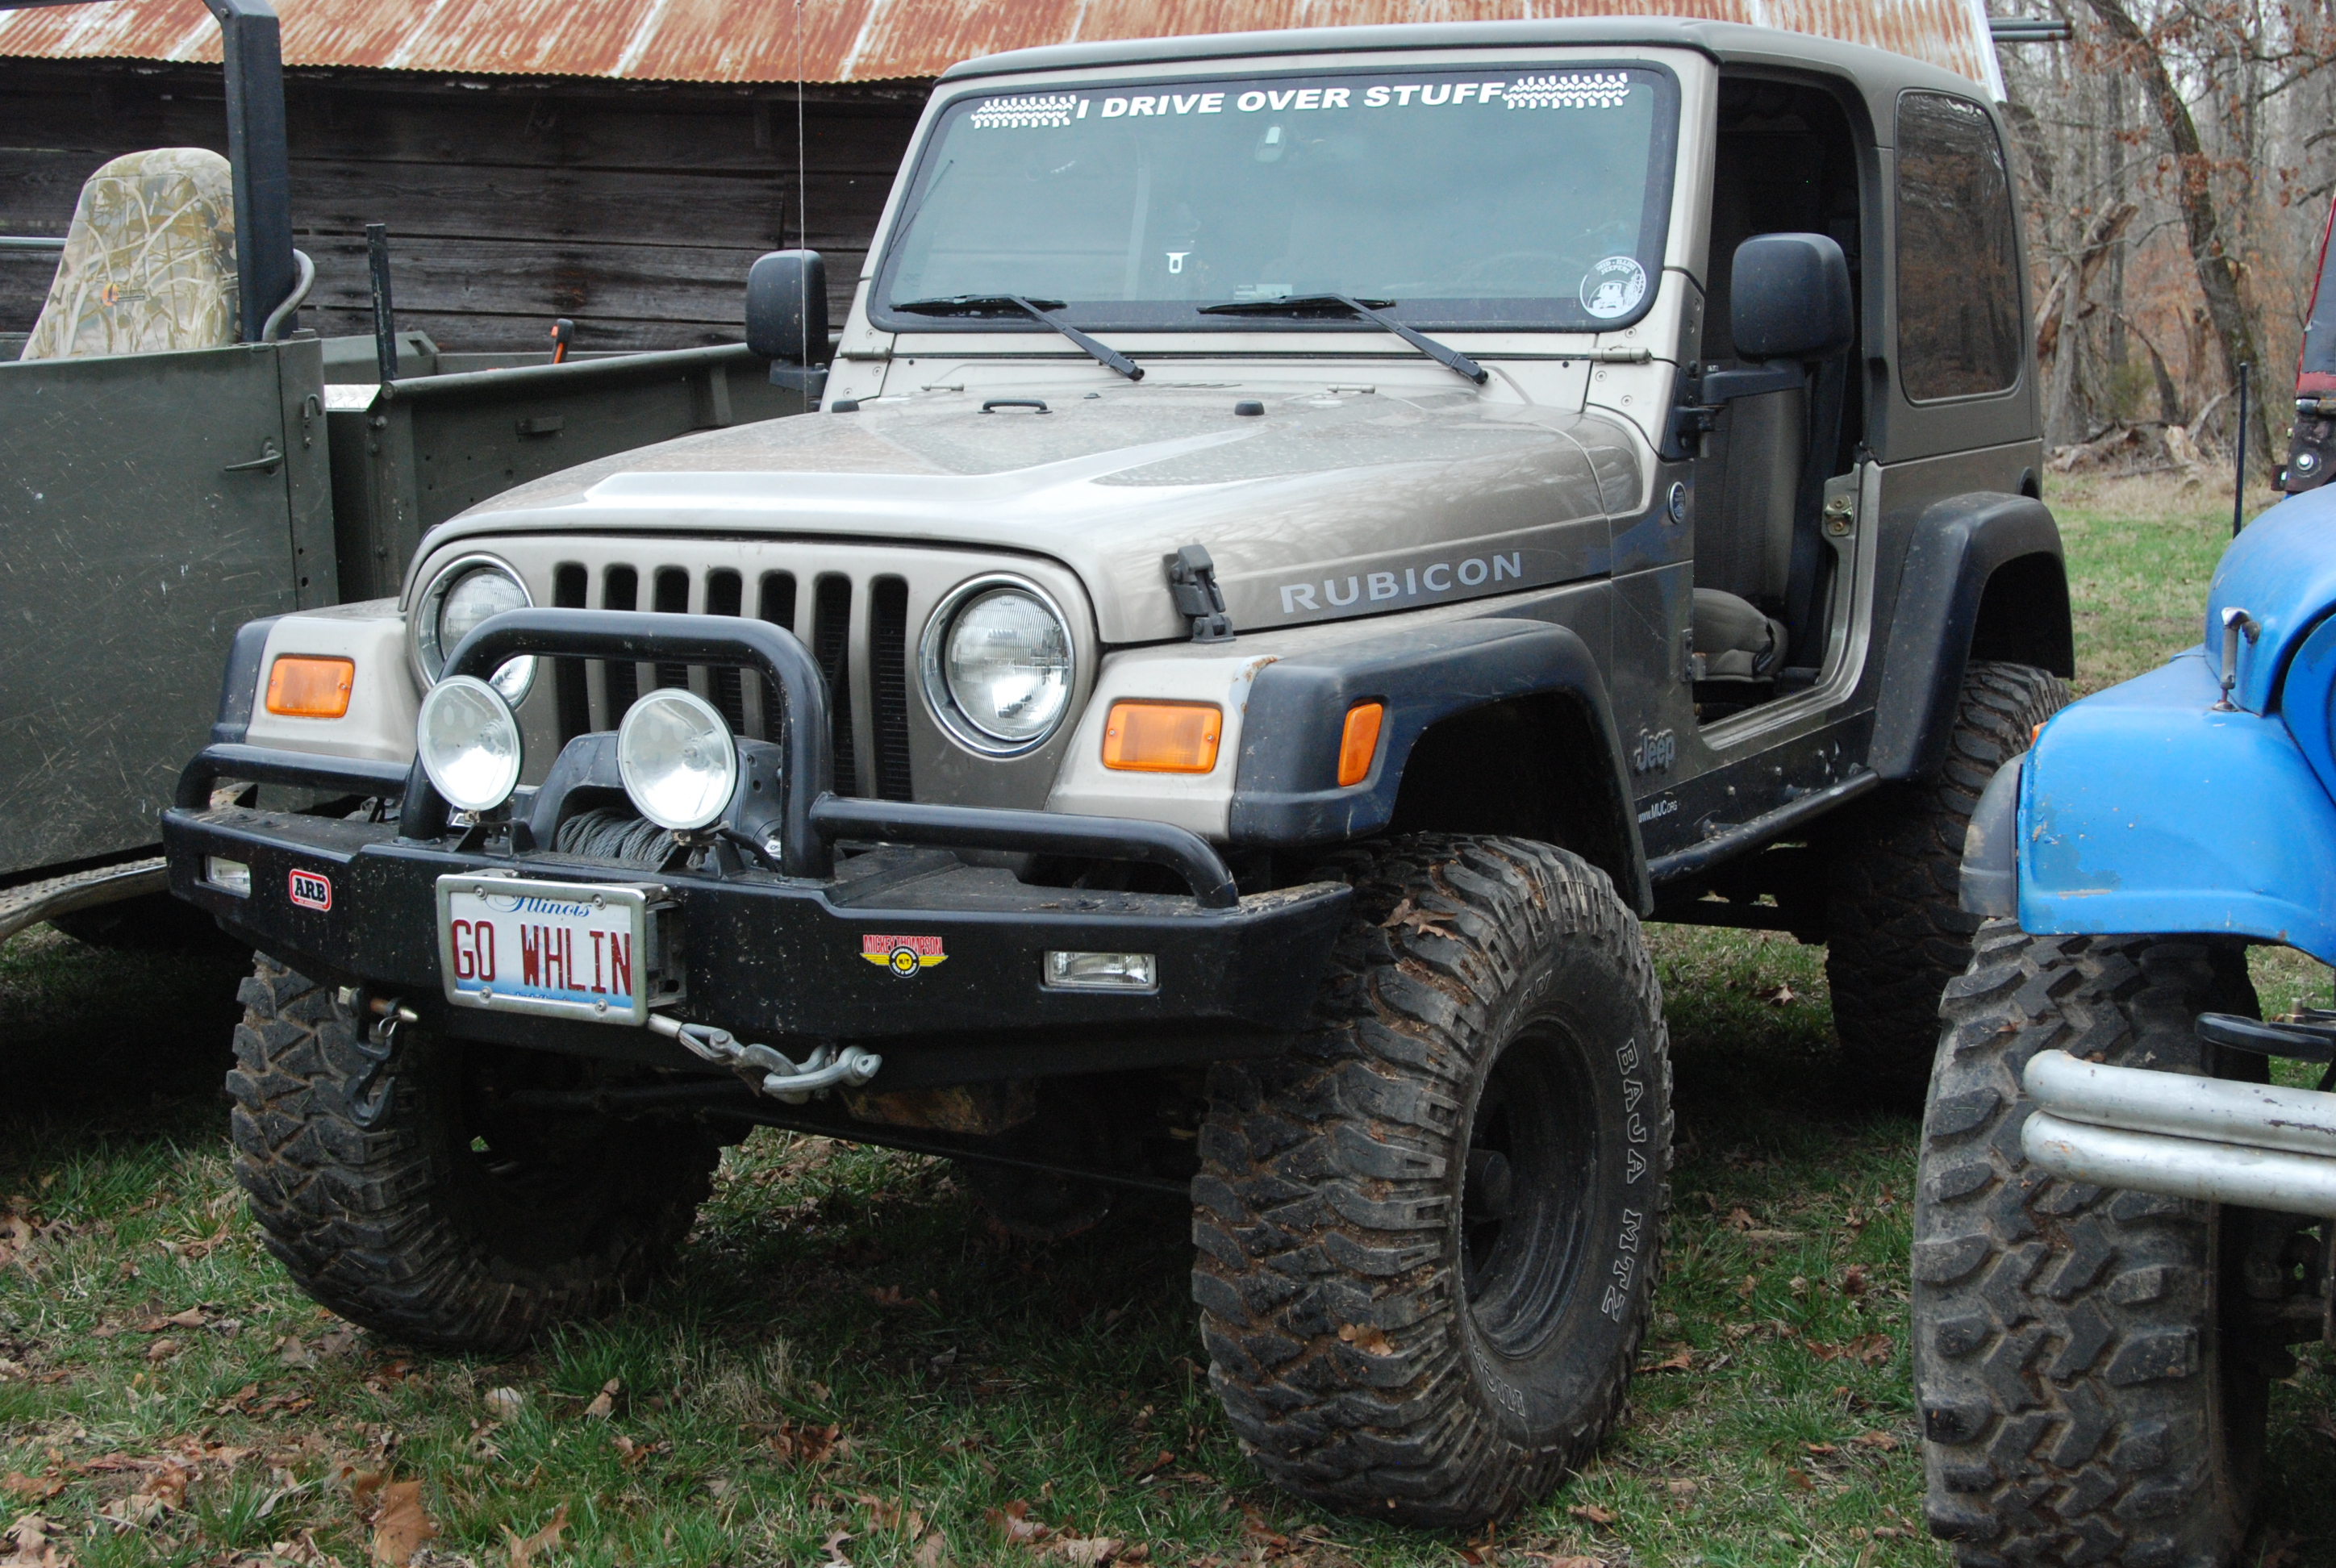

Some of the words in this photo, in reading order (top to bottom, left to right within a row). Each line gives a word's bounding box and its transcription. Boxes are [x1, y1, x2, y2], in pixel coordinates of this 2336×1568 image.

[1075, 93, 1090, 119] I
[1101, 90, 1225, 118] DRIVE
[1237, 88, 1350, 111] OVER
[1363, 82, 1506, 106] STUFF
[1600, 265, 1631, 275] JEEPERS
[1281, 552, 1522, 615] RUBICON
[1634, 728, 1675, 774] Jeep
[294, 877, 327, 903] ARB
[485, 896, 593, 918] Illinois
[452, 919, 495, 982] GO
[520, 924, 632, 996] WHLIN
[862, 934, 895, 954] MICKEY
[895, 935, 943, 956] THOMPSON
[1616, 1037, 1647, 1184] BAJA
[1601, 1208, 1642, 1323] MTZ
